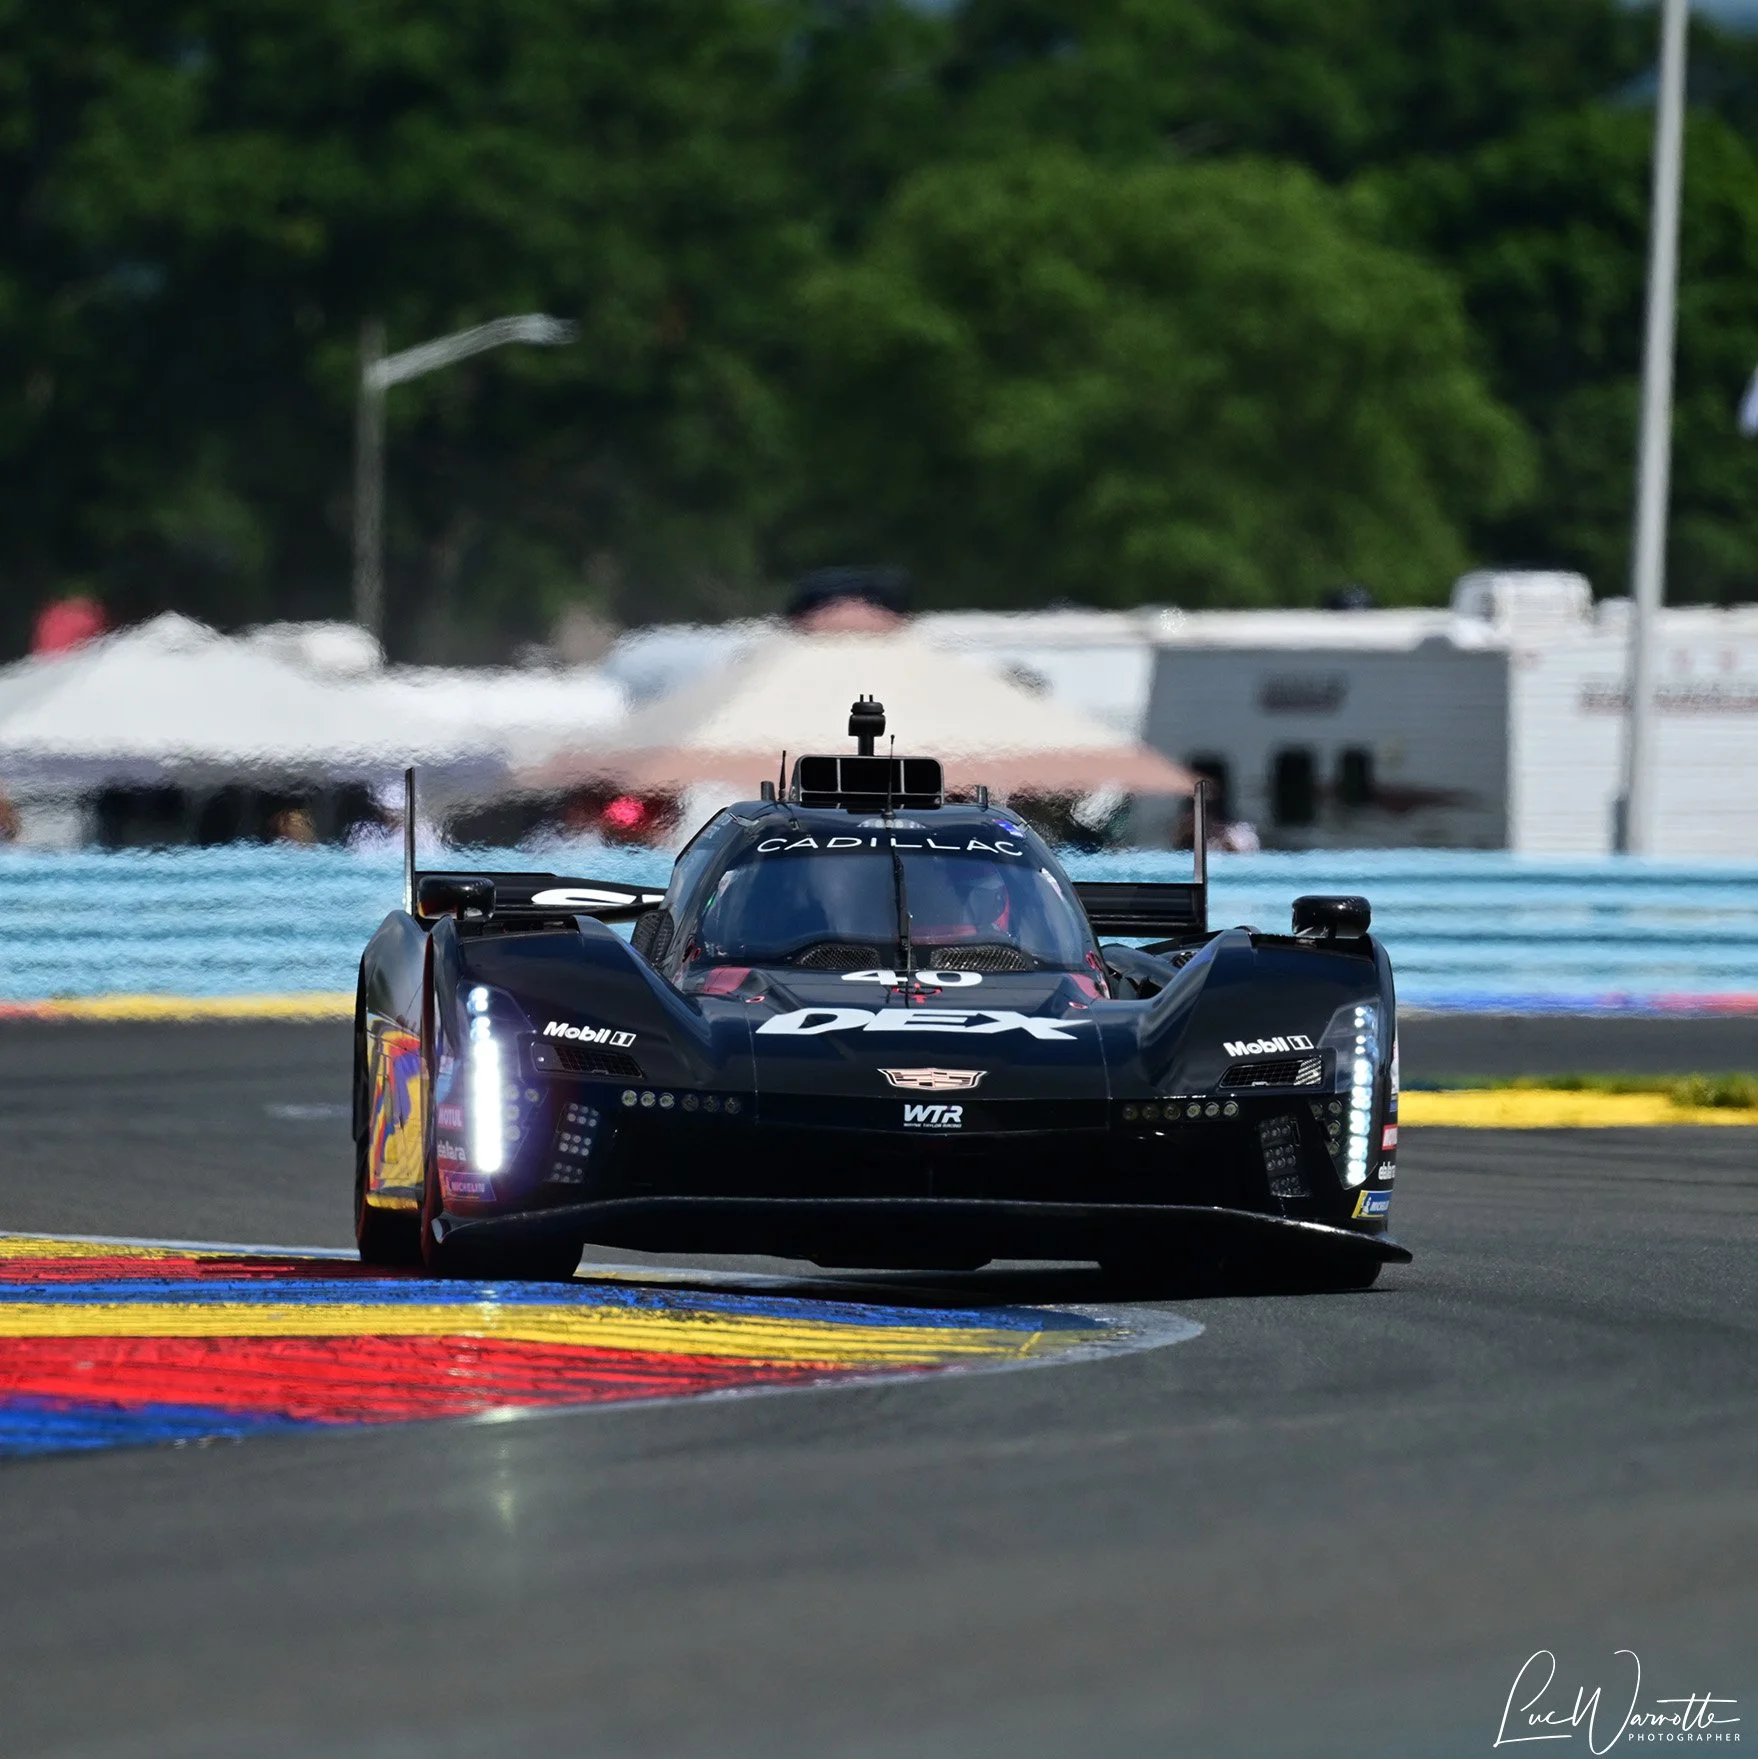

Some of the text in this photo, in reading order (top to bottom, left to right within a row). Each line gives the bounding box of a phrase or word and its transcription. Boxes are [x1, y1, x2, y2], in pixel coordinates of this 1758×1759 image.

[757, 837, 1023, 856] CADILLAC
[841, 970, 983, 987] 40
[543, 1021, 612, 1044] Mobil
[755, 1007, 1093, 1040] DEX
[1223, 1035, 1315, 1057] Mobil 1
[904, 1104, 963, 1123] WTR
